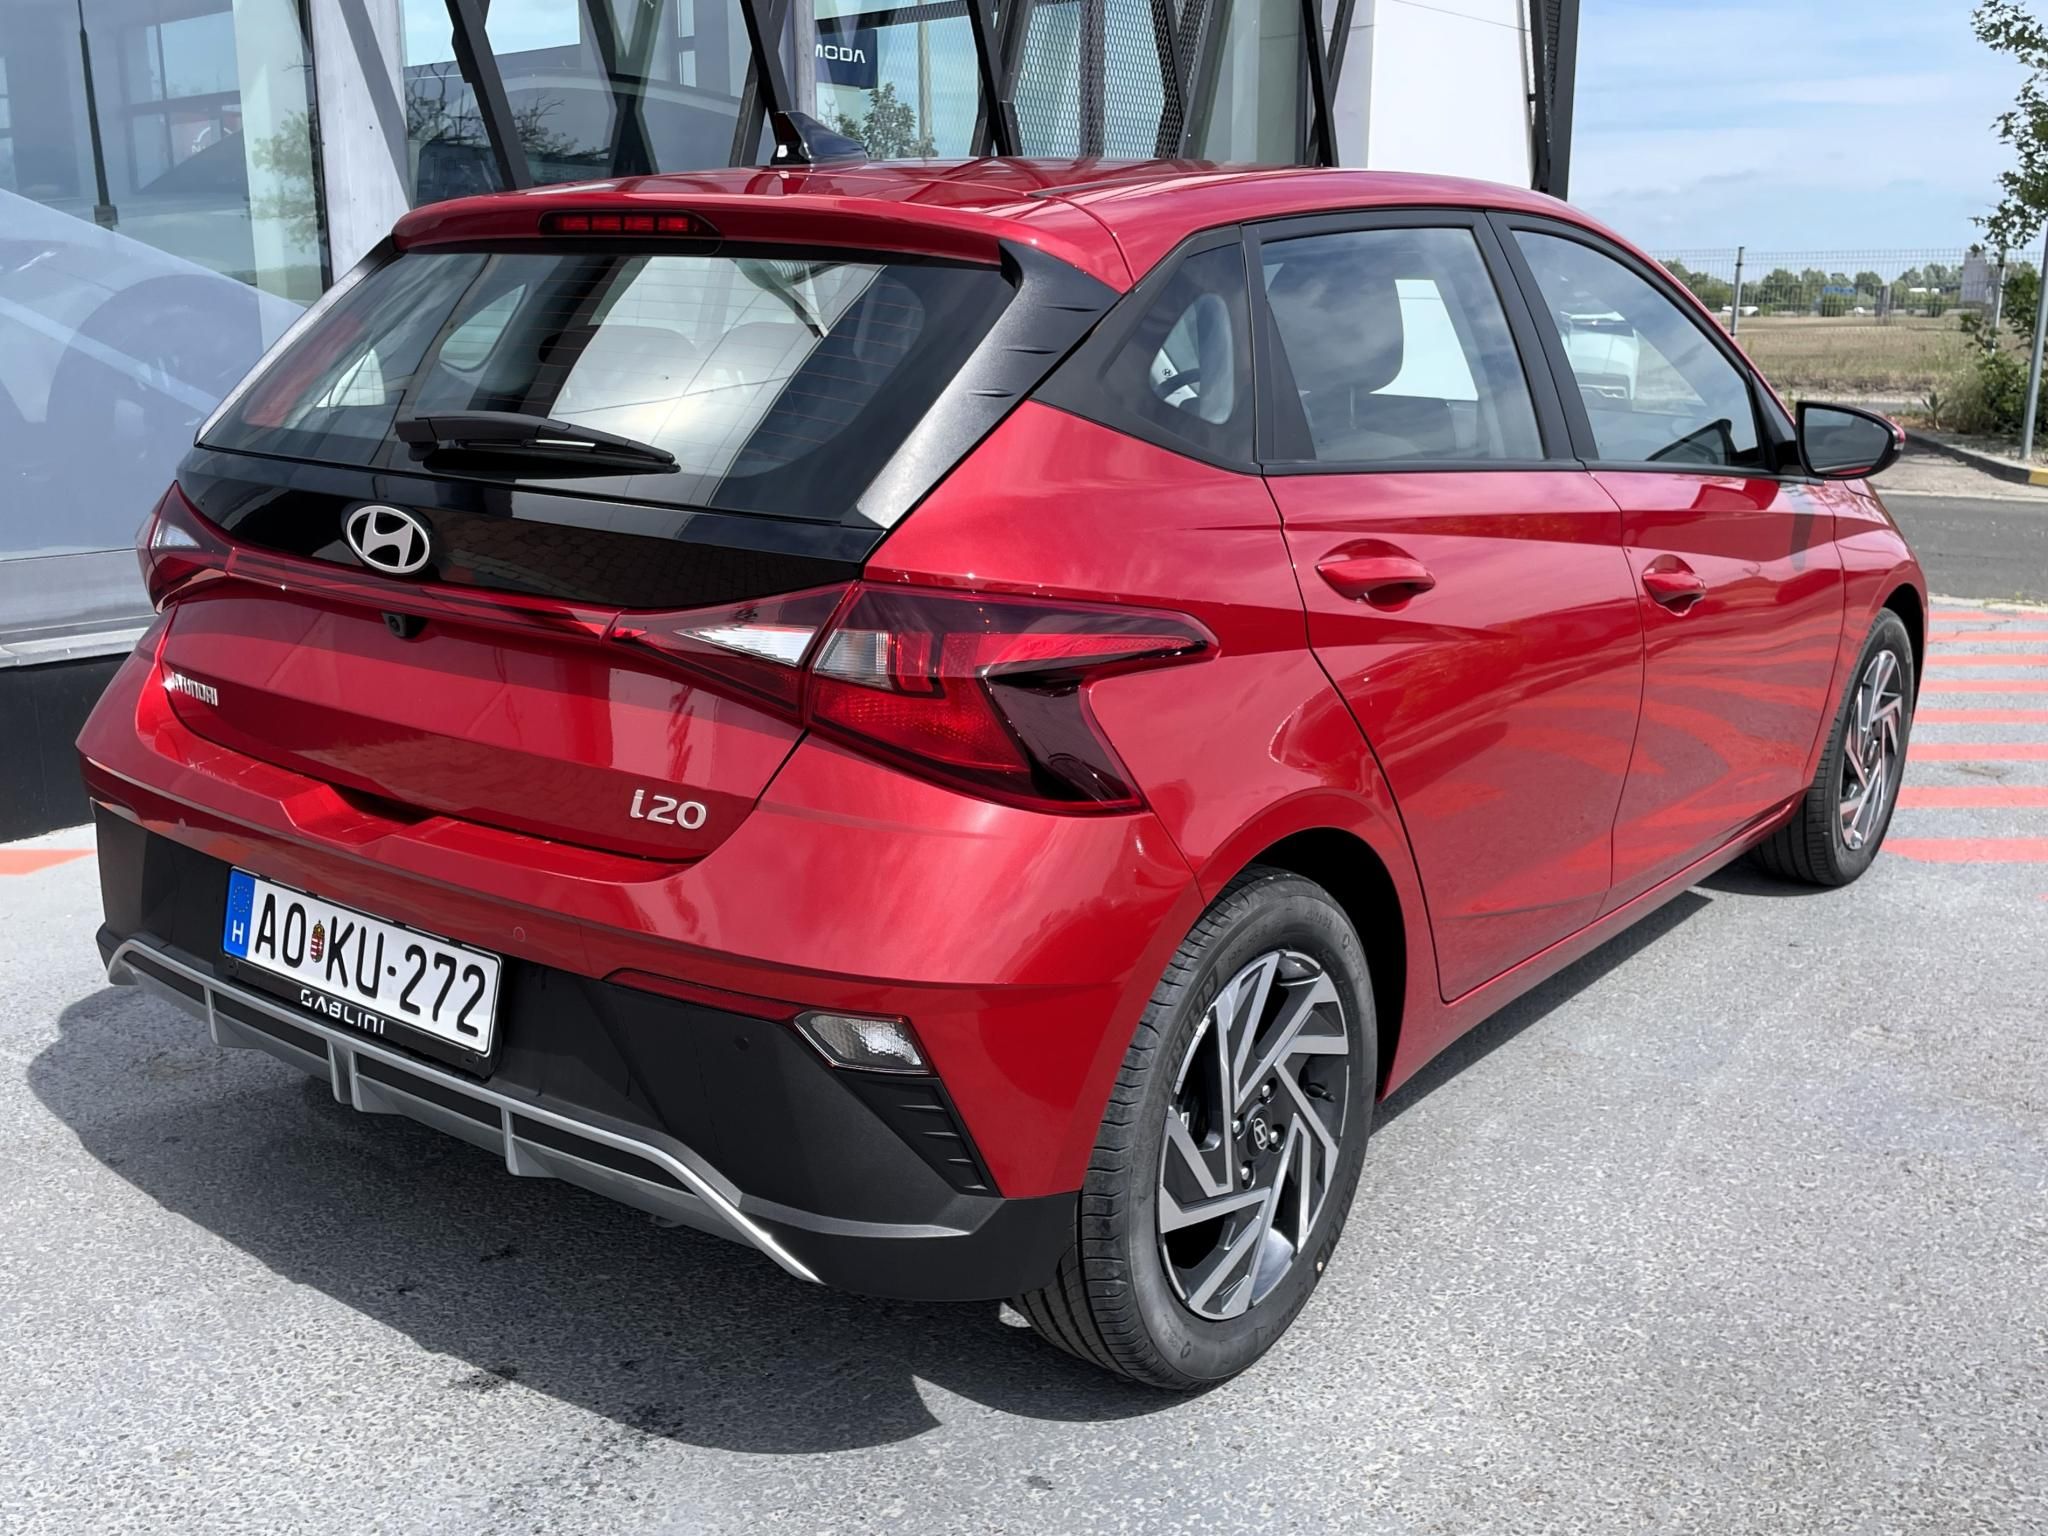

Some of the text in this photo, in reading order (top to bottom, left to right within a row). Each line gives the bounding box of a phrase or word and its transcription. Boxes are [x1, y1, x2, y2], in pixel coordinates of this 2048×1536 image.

[630, 789, 707, 830] i20
[231, 919, 245, 945] H
[300, 989, 385, 1035] GABLINI
